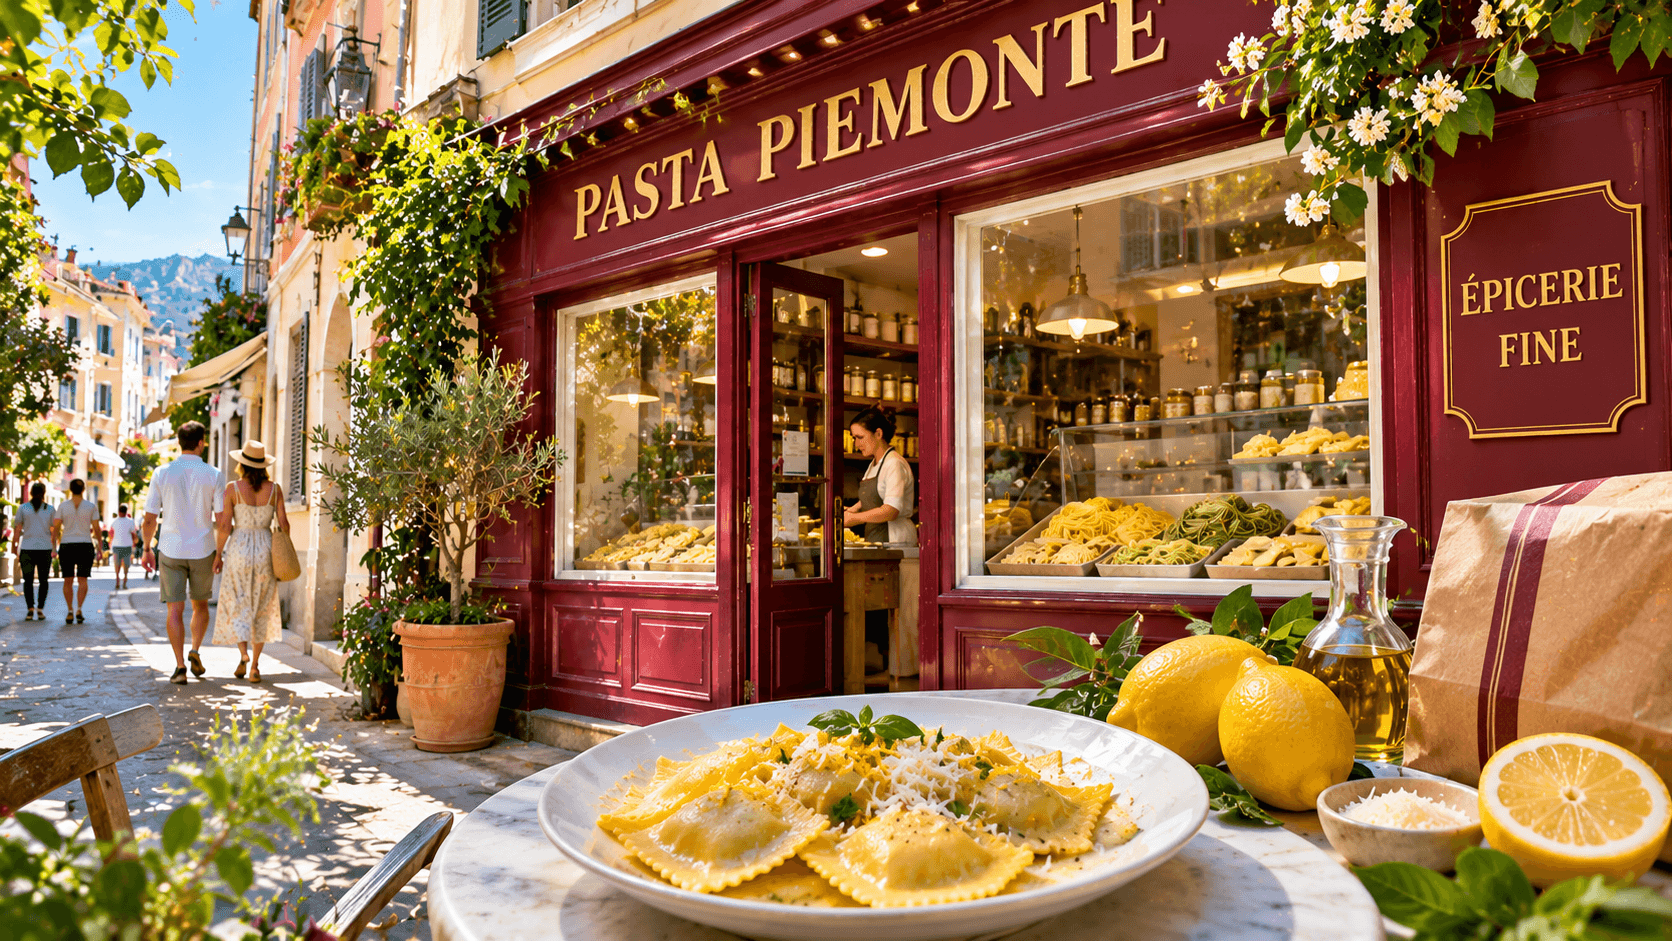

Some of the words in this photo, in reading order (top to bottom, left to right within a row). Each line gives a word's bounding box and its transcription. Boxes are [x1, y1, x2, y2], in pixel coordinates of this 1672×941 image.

[573, 140, 730, 241] PASTA
[756, 0, 1165, 182] PIEMONTE
[1460, 262, 1623, 316] ÉPICERIE
[1498, 326, 1582, 368] FINE
